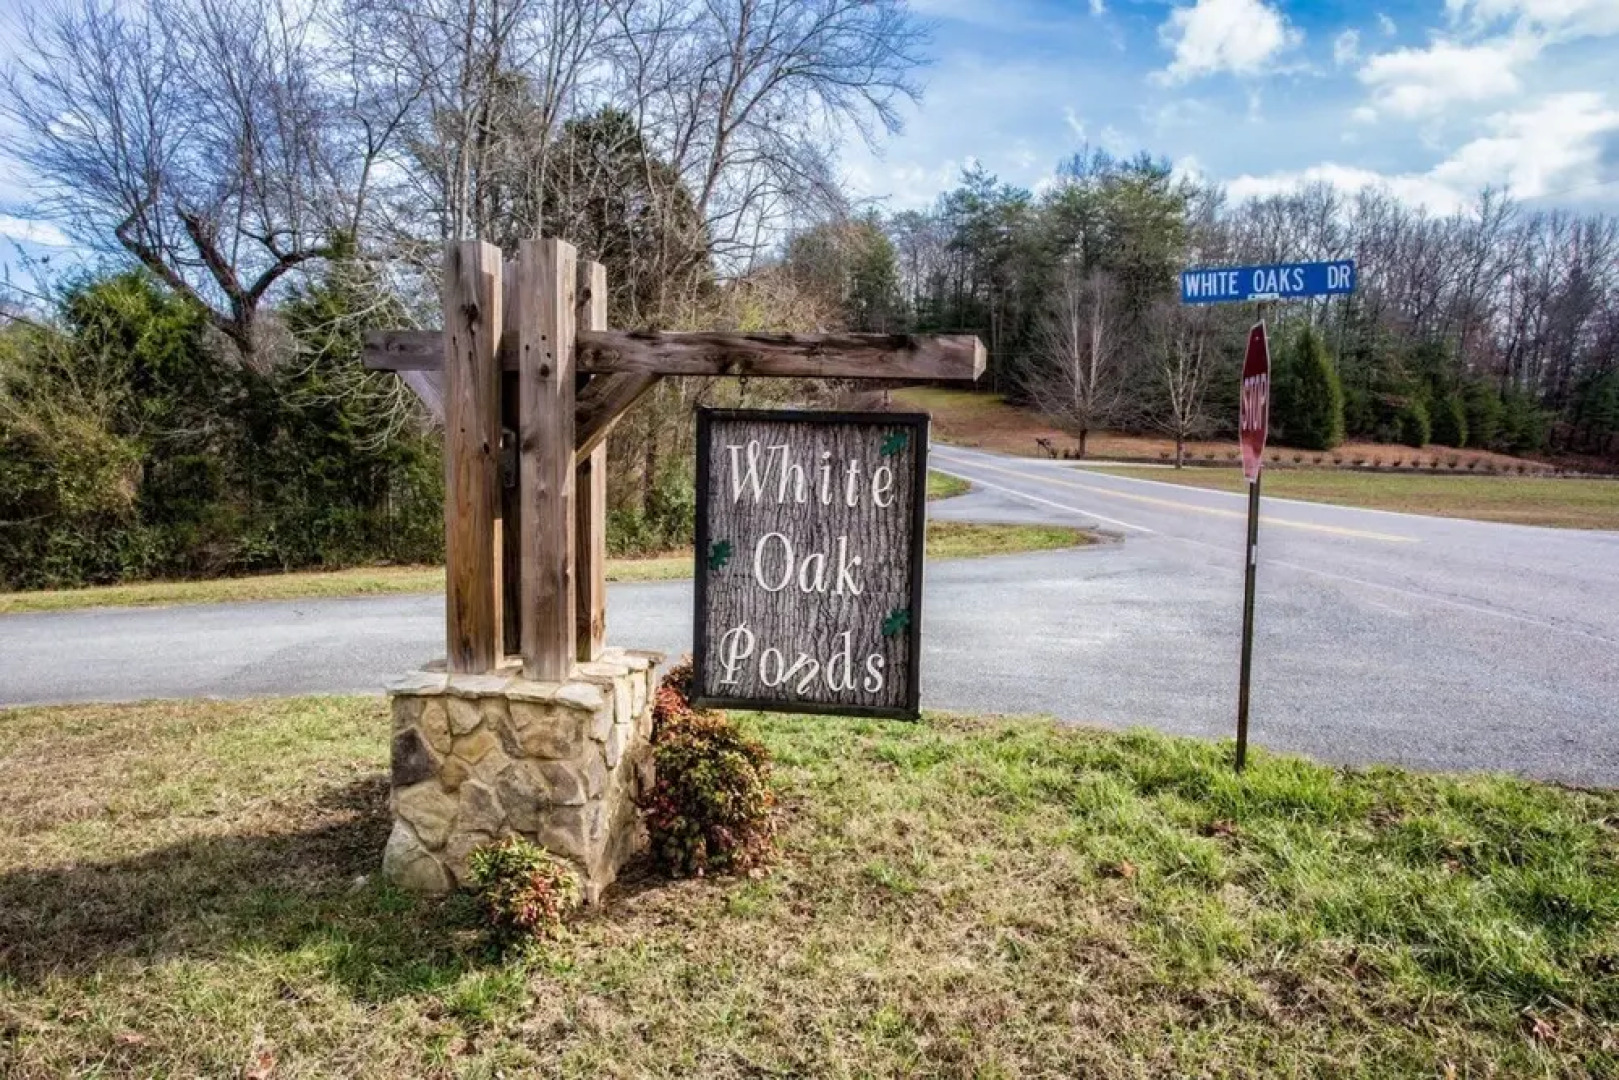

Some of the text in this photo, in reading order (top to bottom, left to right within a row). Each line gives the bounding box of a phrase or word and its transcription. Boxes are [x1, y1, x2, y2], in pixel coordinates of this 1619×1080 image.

[1184, 265, 1351, 297] WHITE OAKS DR
[1242, 373, 1267, 431] STOP
[726, 440, 895, 508] White
[754, 532, 864, 597] Oak
[719, 620, 885, 696] Ponds
